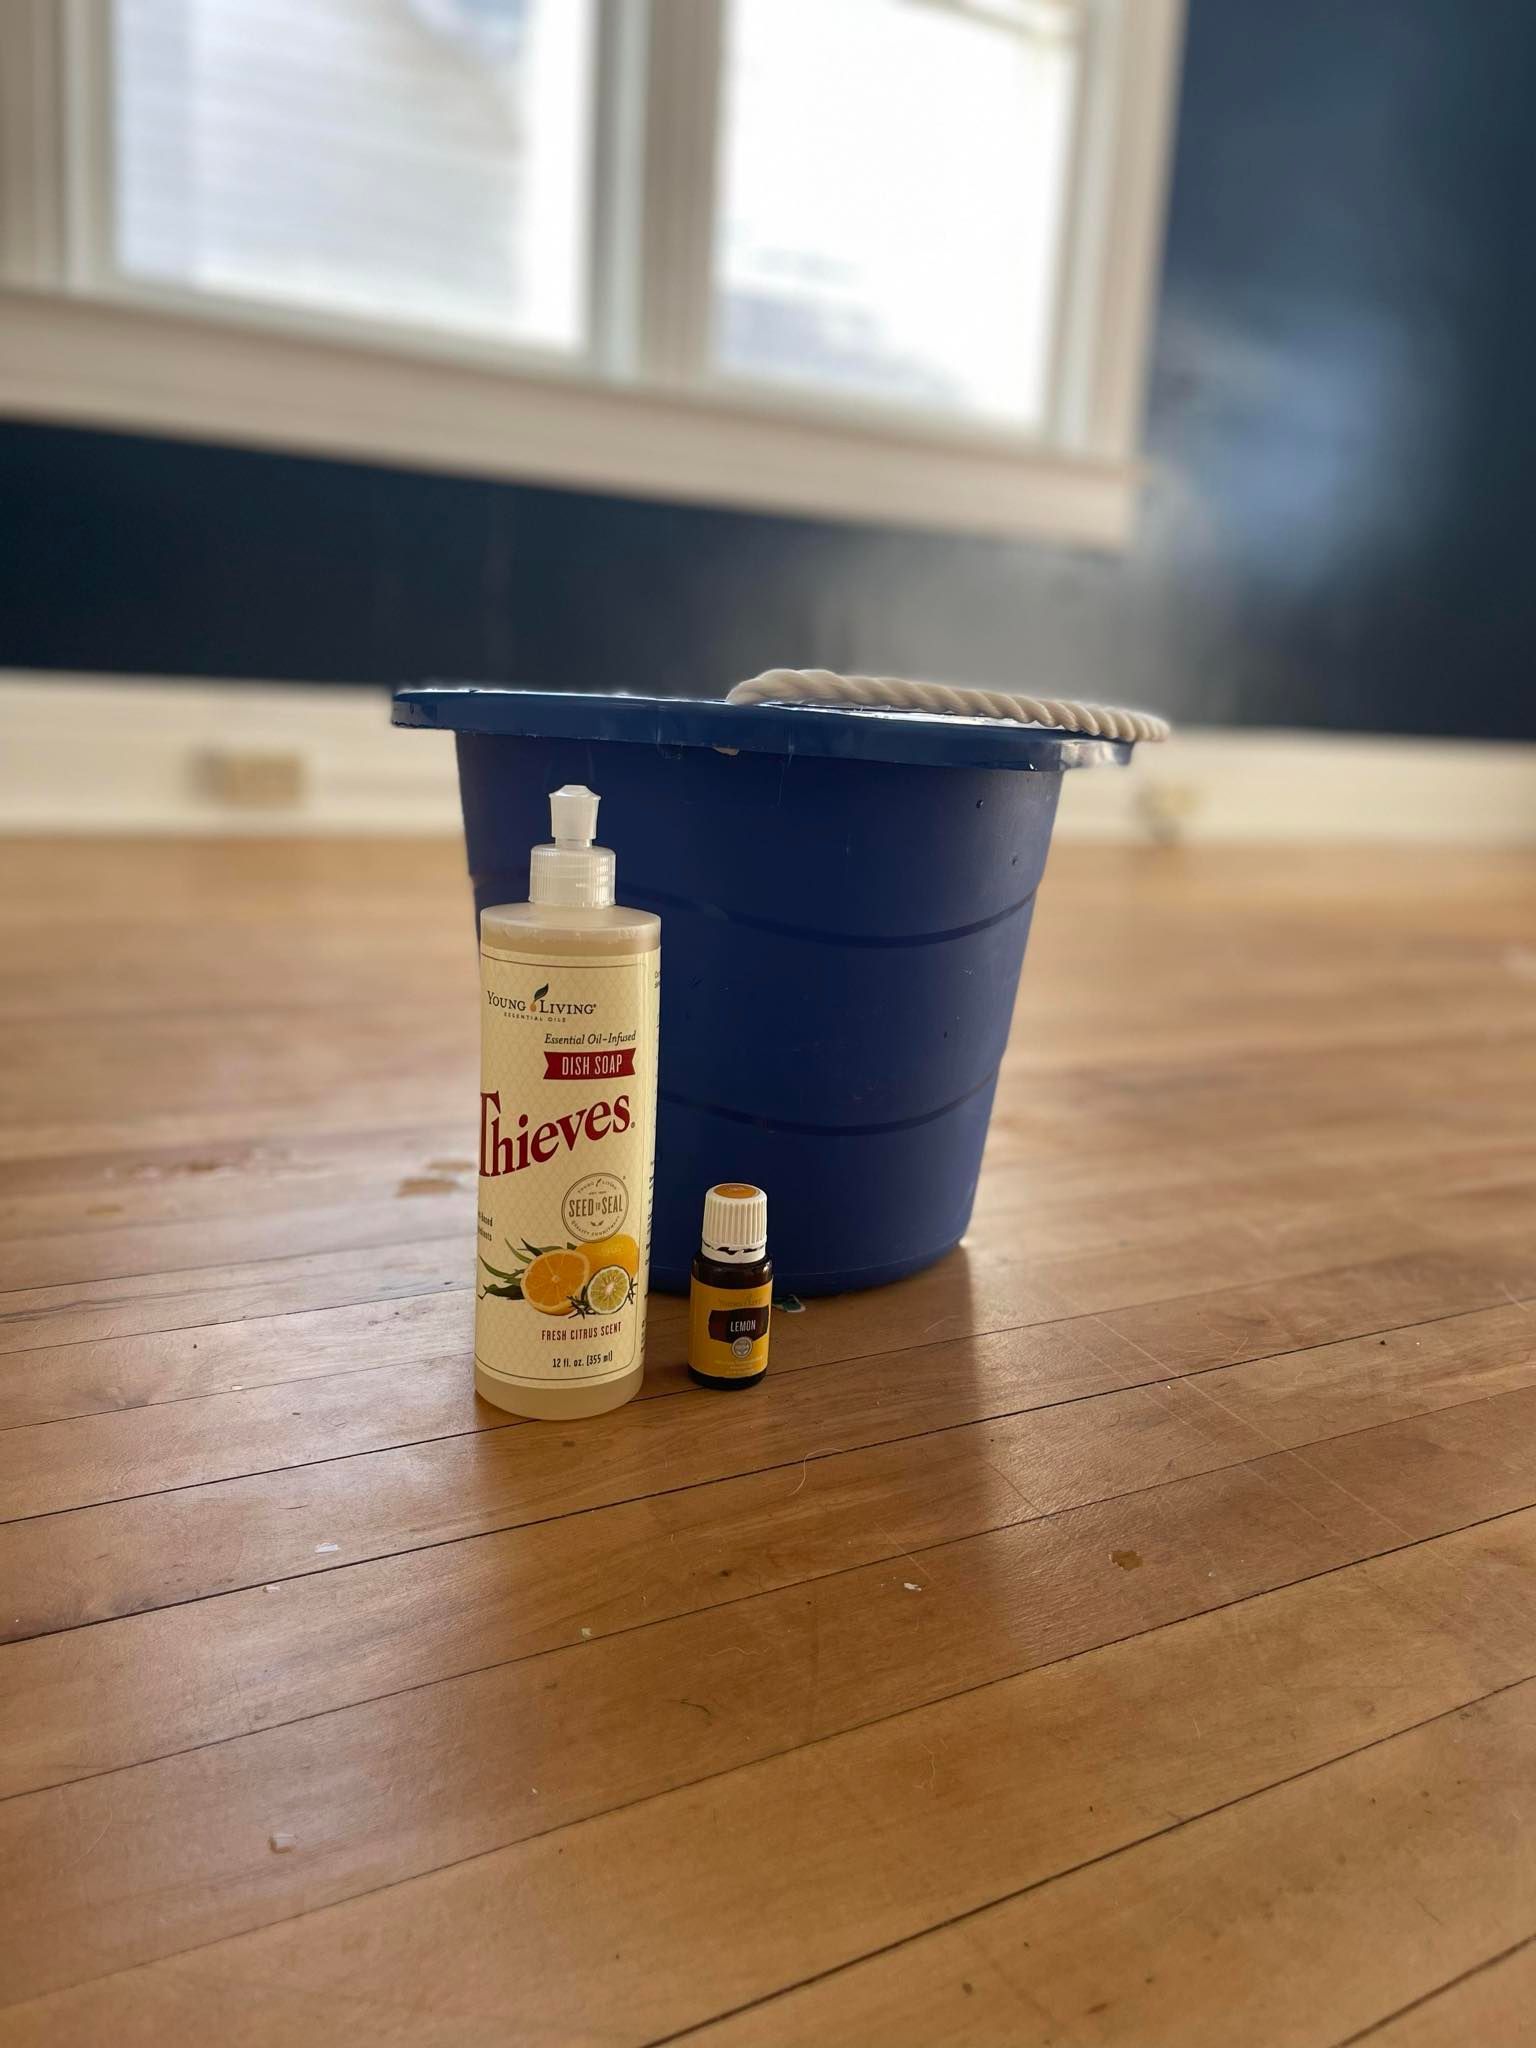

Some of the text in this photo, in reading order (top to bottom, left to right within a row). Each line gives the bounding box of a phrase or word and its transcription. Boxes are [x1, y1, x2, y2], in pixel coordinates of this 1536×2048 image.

[487, 990, 526, 1012] YOUNG
[504, 1012, 543, 1022] ESSENTIAL
[544, 1030, 637, 1047] Essential Oil-Infused
[562, 1054, 623, 1076] DISH SOAP
[569, 1198, 594, 1218] SEED
[602, 1194, 623, 1215] SEAL
[541, 1321, 622, 1341] FRESH CITRUS SCENT
[730, 1319, 756, 1333] LEMON
[552, 1358, 561, 1368] 12
[573, 1359, 584, 1367] oz.
